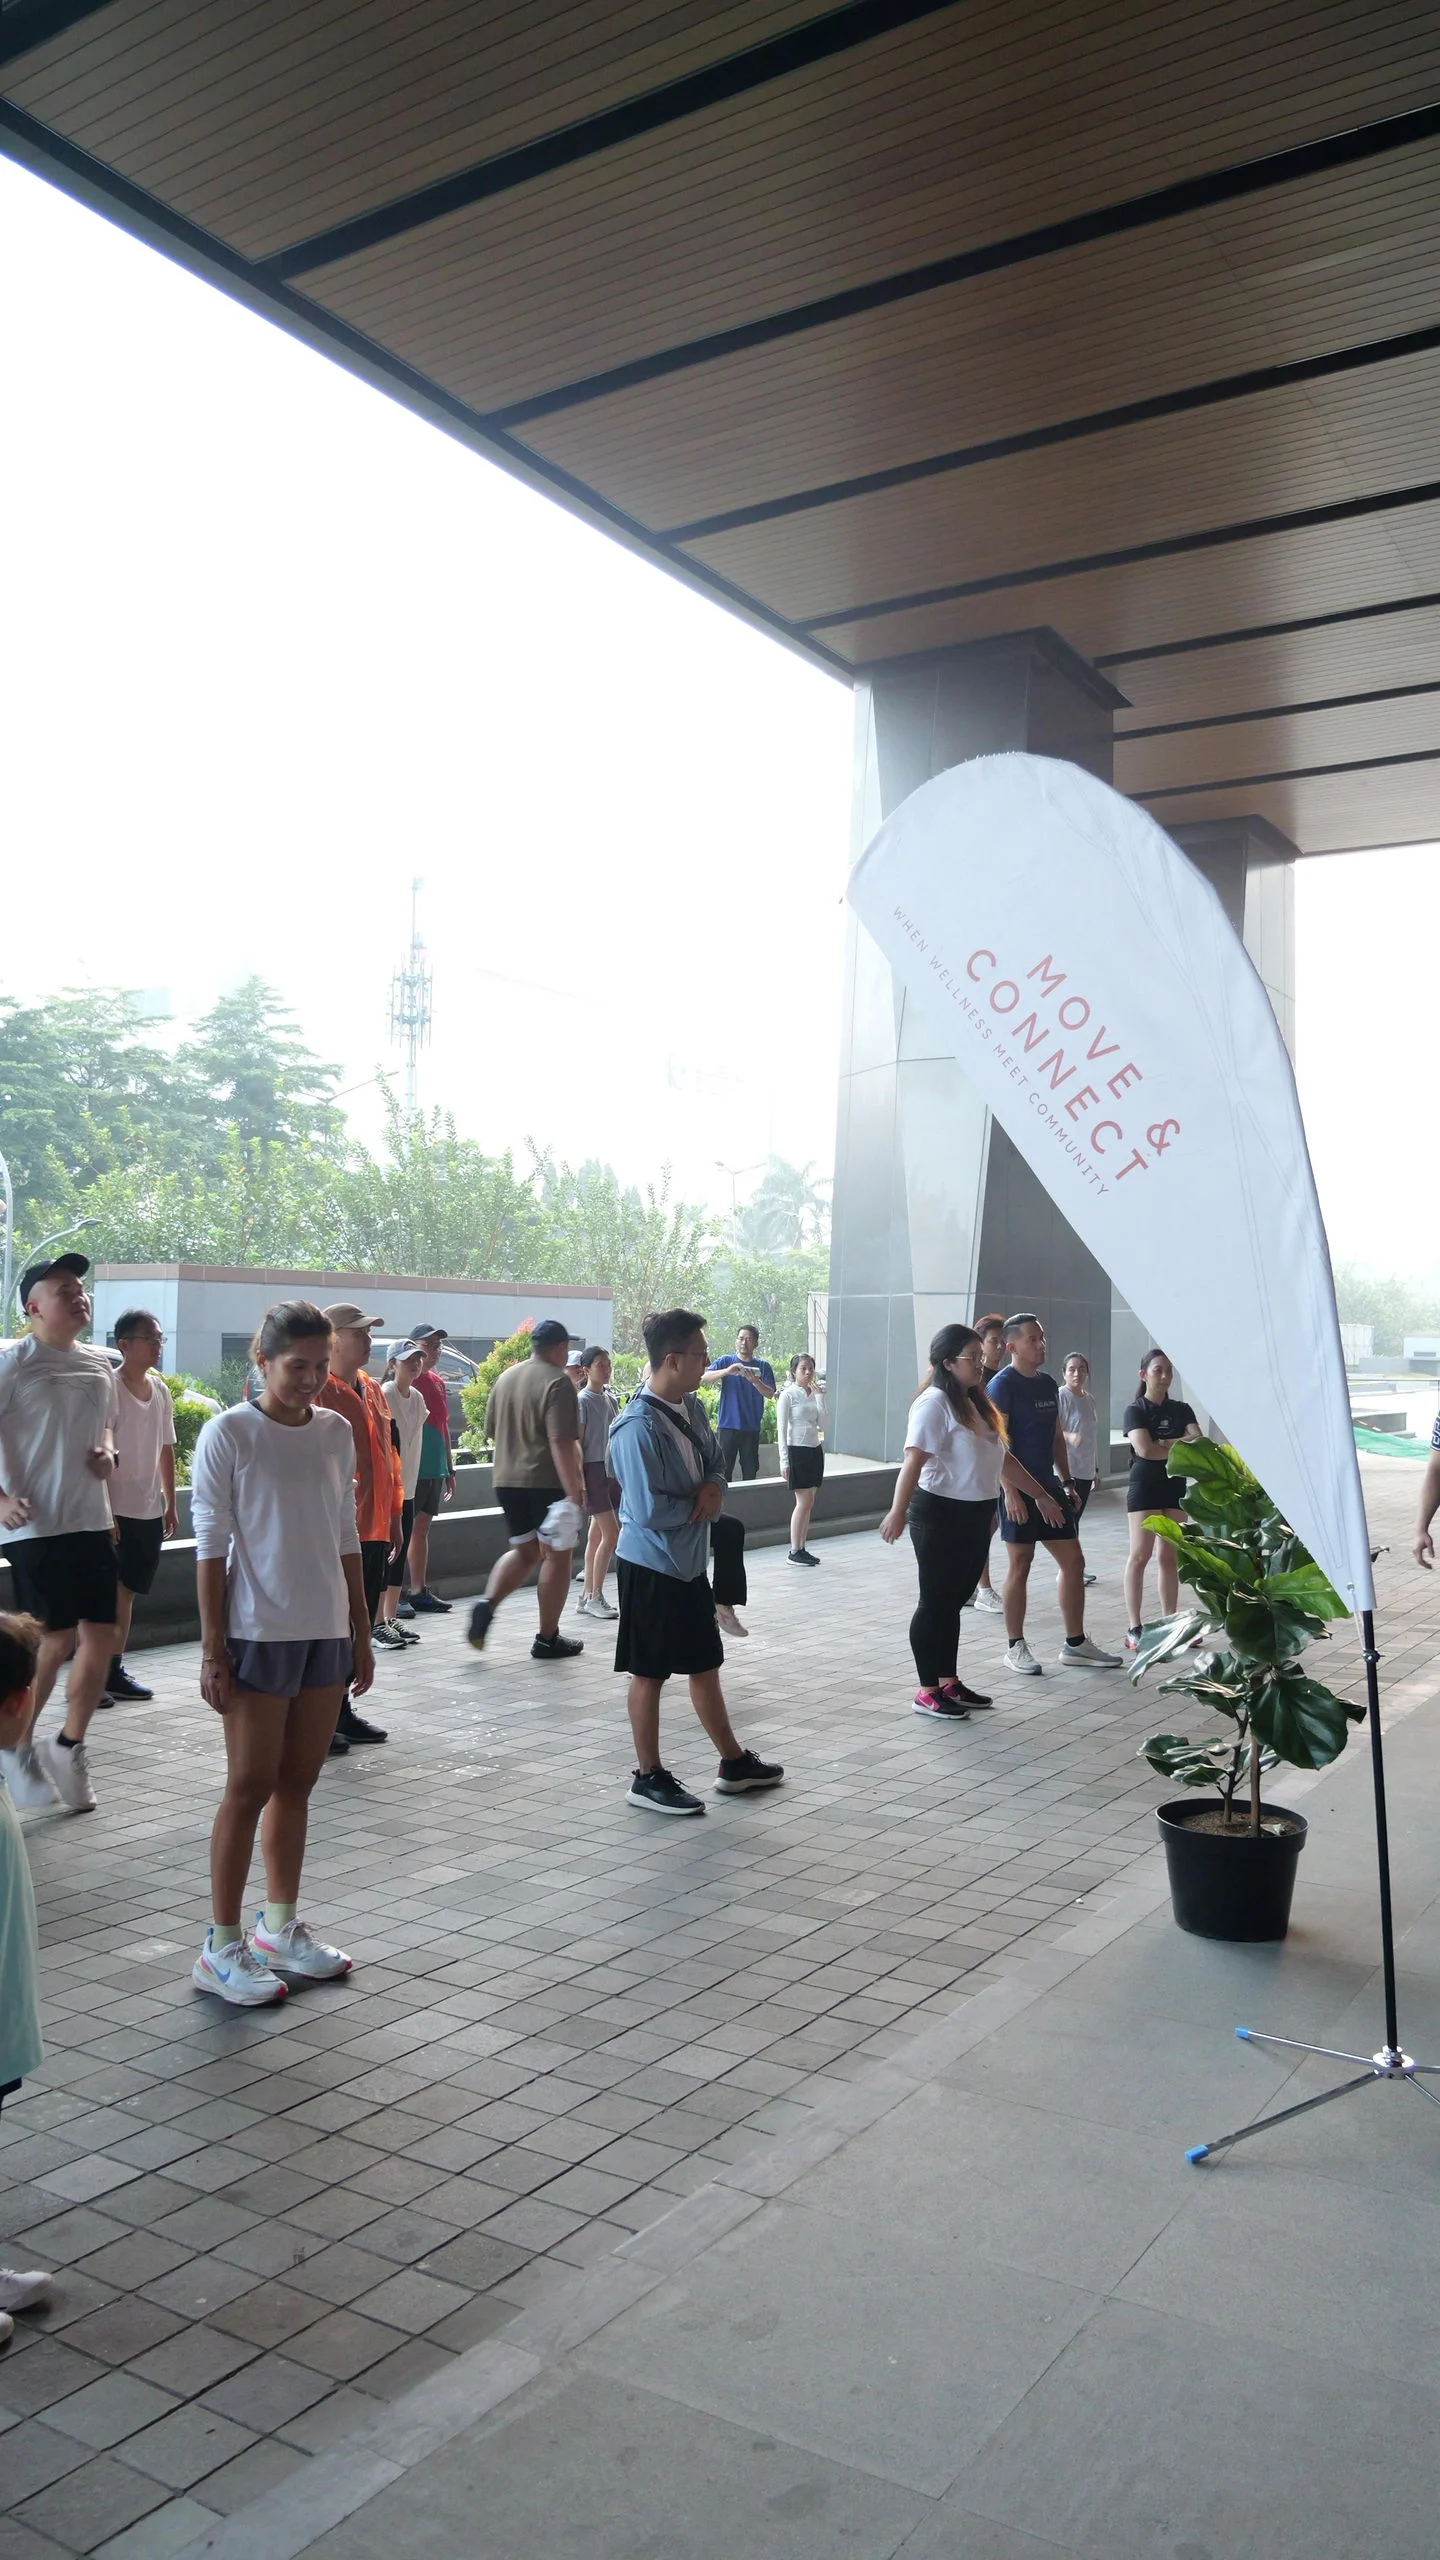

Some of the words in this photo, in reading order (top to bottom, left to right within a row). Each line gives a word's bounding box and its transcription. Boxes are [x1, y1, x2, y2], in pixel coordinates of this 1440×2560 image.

[893, 905, 929, 953] WHEN
[929, 955, 993, 1040] WELLNESS
[992, 1043, 1029, 1087] MEET
[1028, 1092, 1110, 1196] COMMUNITY
[966, 948, 1149, 1181] CONNECT
[1026, 953, 1144, 1101] MOVE
[1145, 1118, 1181, 1158] &
